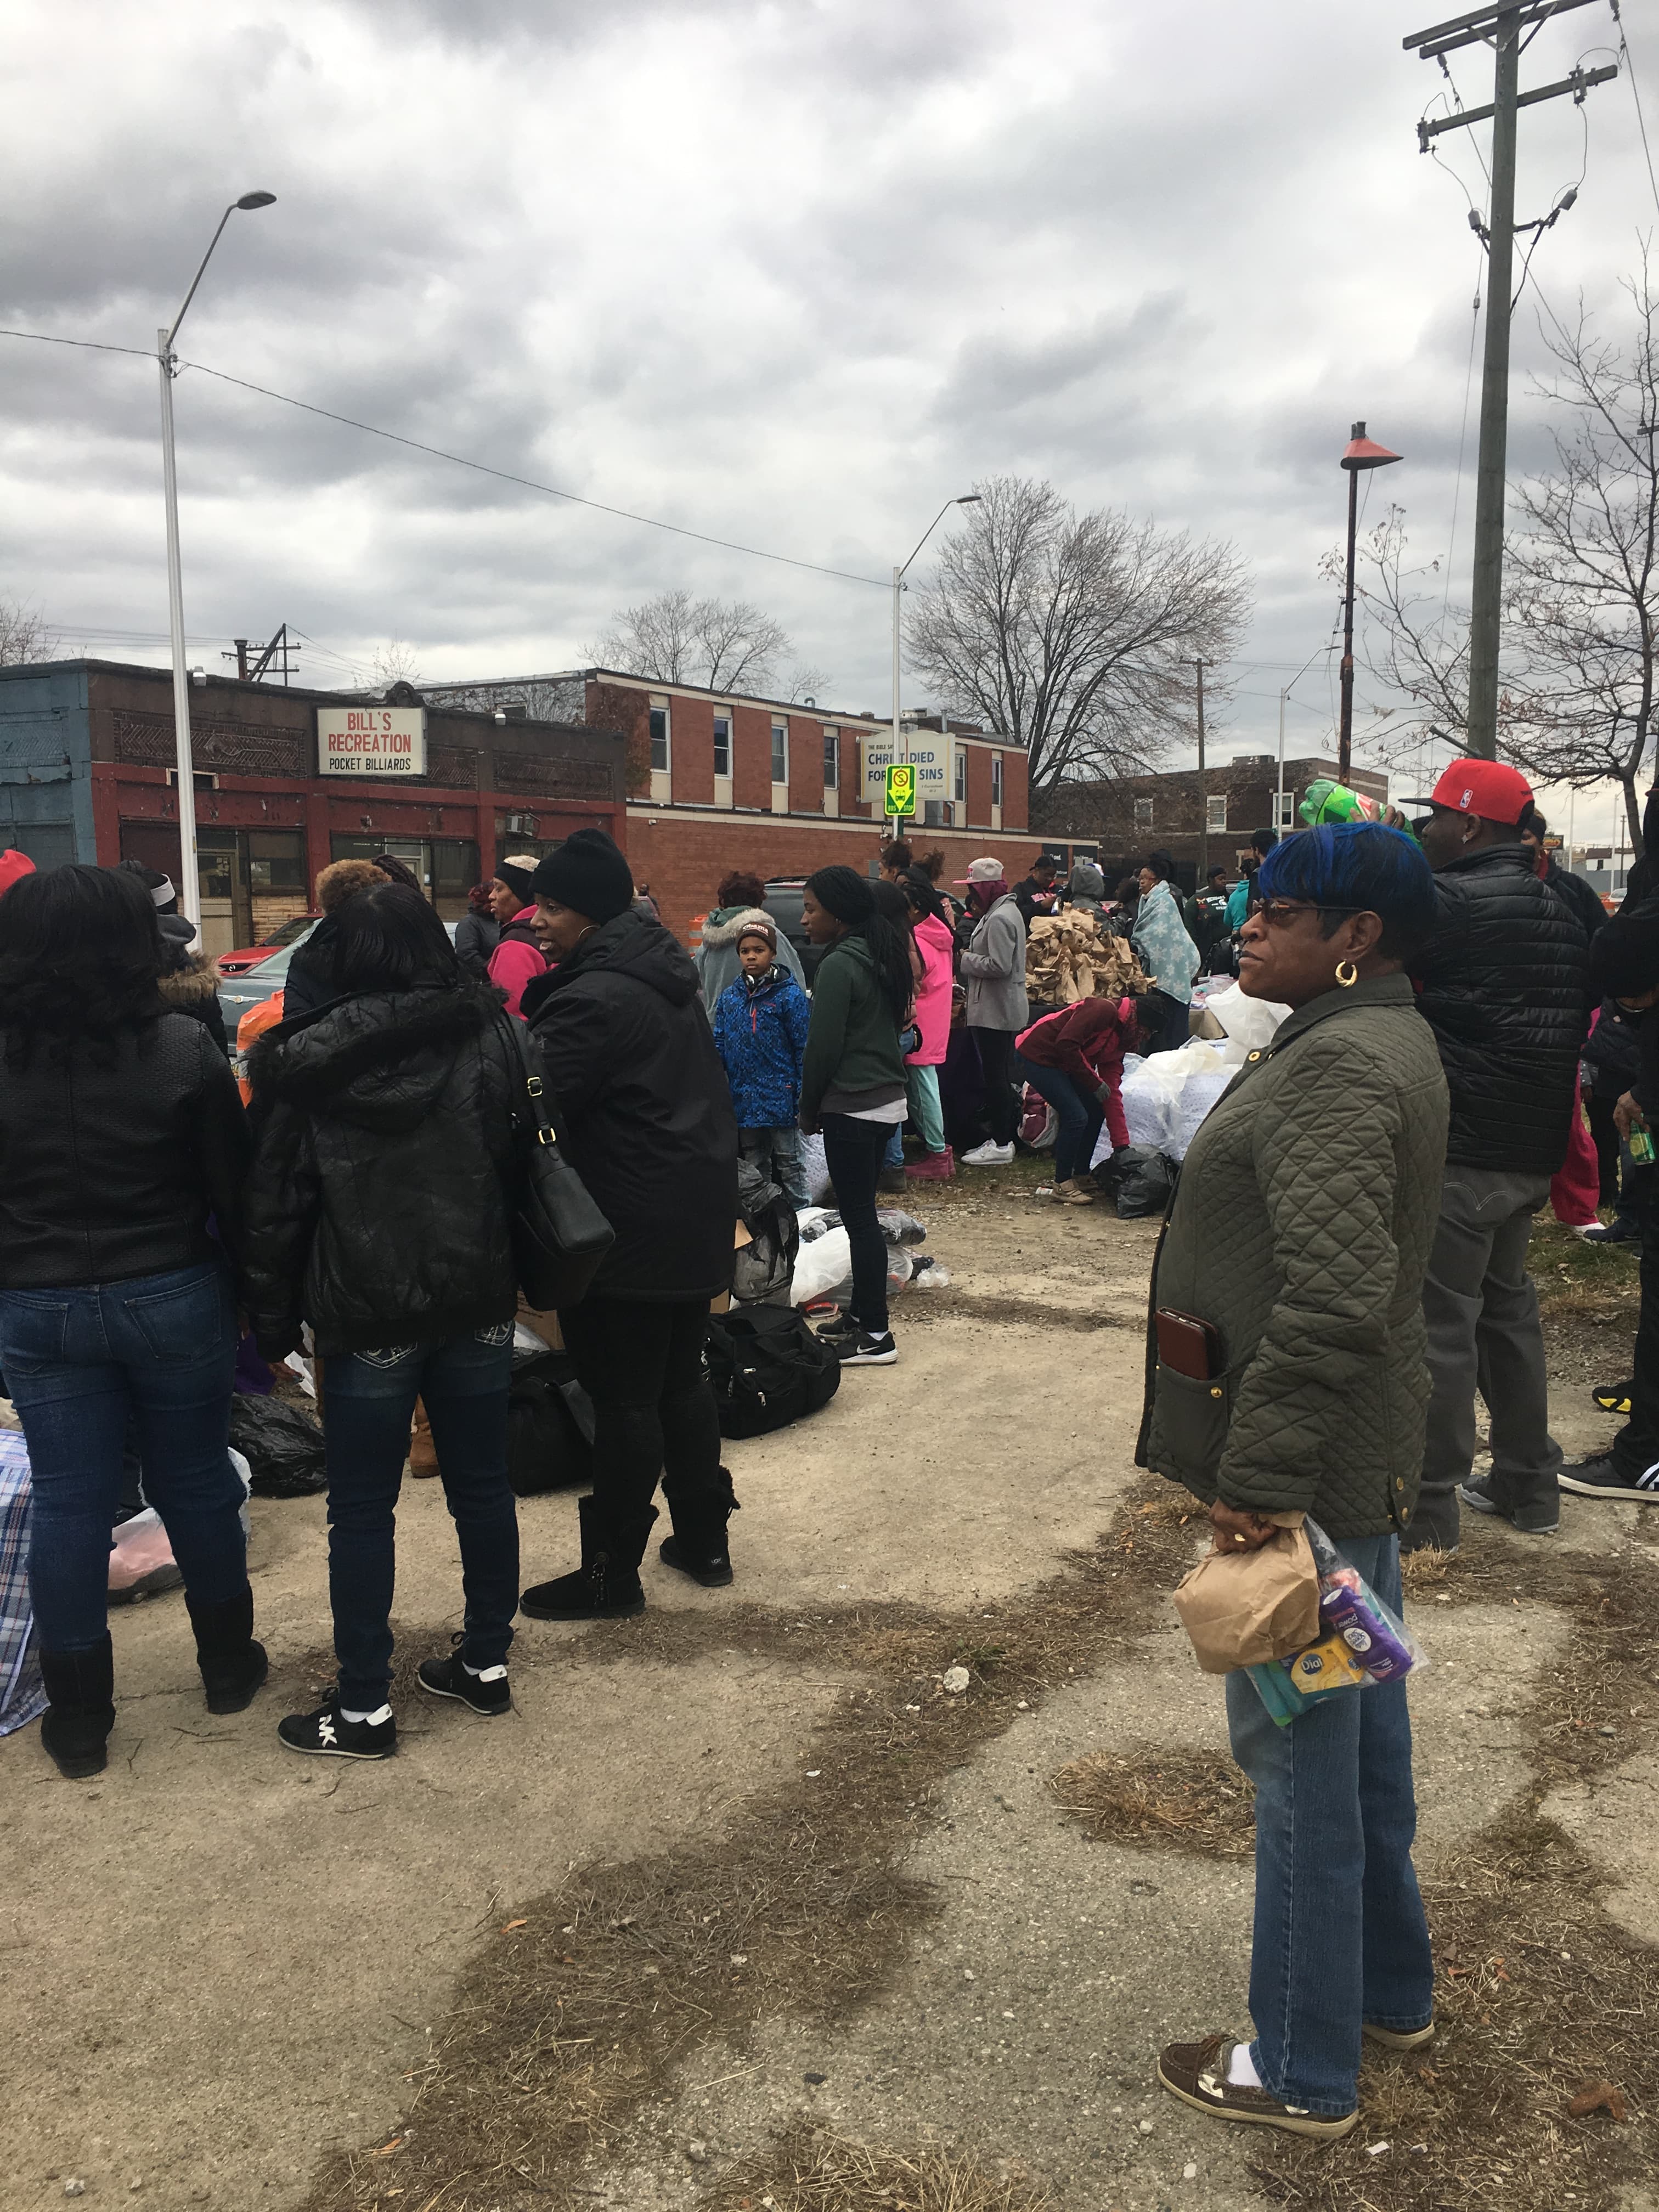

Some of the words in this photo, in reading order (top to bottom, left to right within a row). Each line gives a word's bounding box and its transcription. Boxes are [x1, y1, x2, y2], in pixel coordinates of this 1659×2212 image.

[348, 712, 391, 731] BILL'S
[329, 733, 411, 753] RECREATION
[330, 758, 361, 770] POCKET
[366, 758, 410, 770] BILLIARDS
[868, 753, 905, 765] CHRIT
[910, 752, 934, 763] DIED
[919, 769, 943, 780] SINS
[1301, 1658, 1323, 1671] Dial
